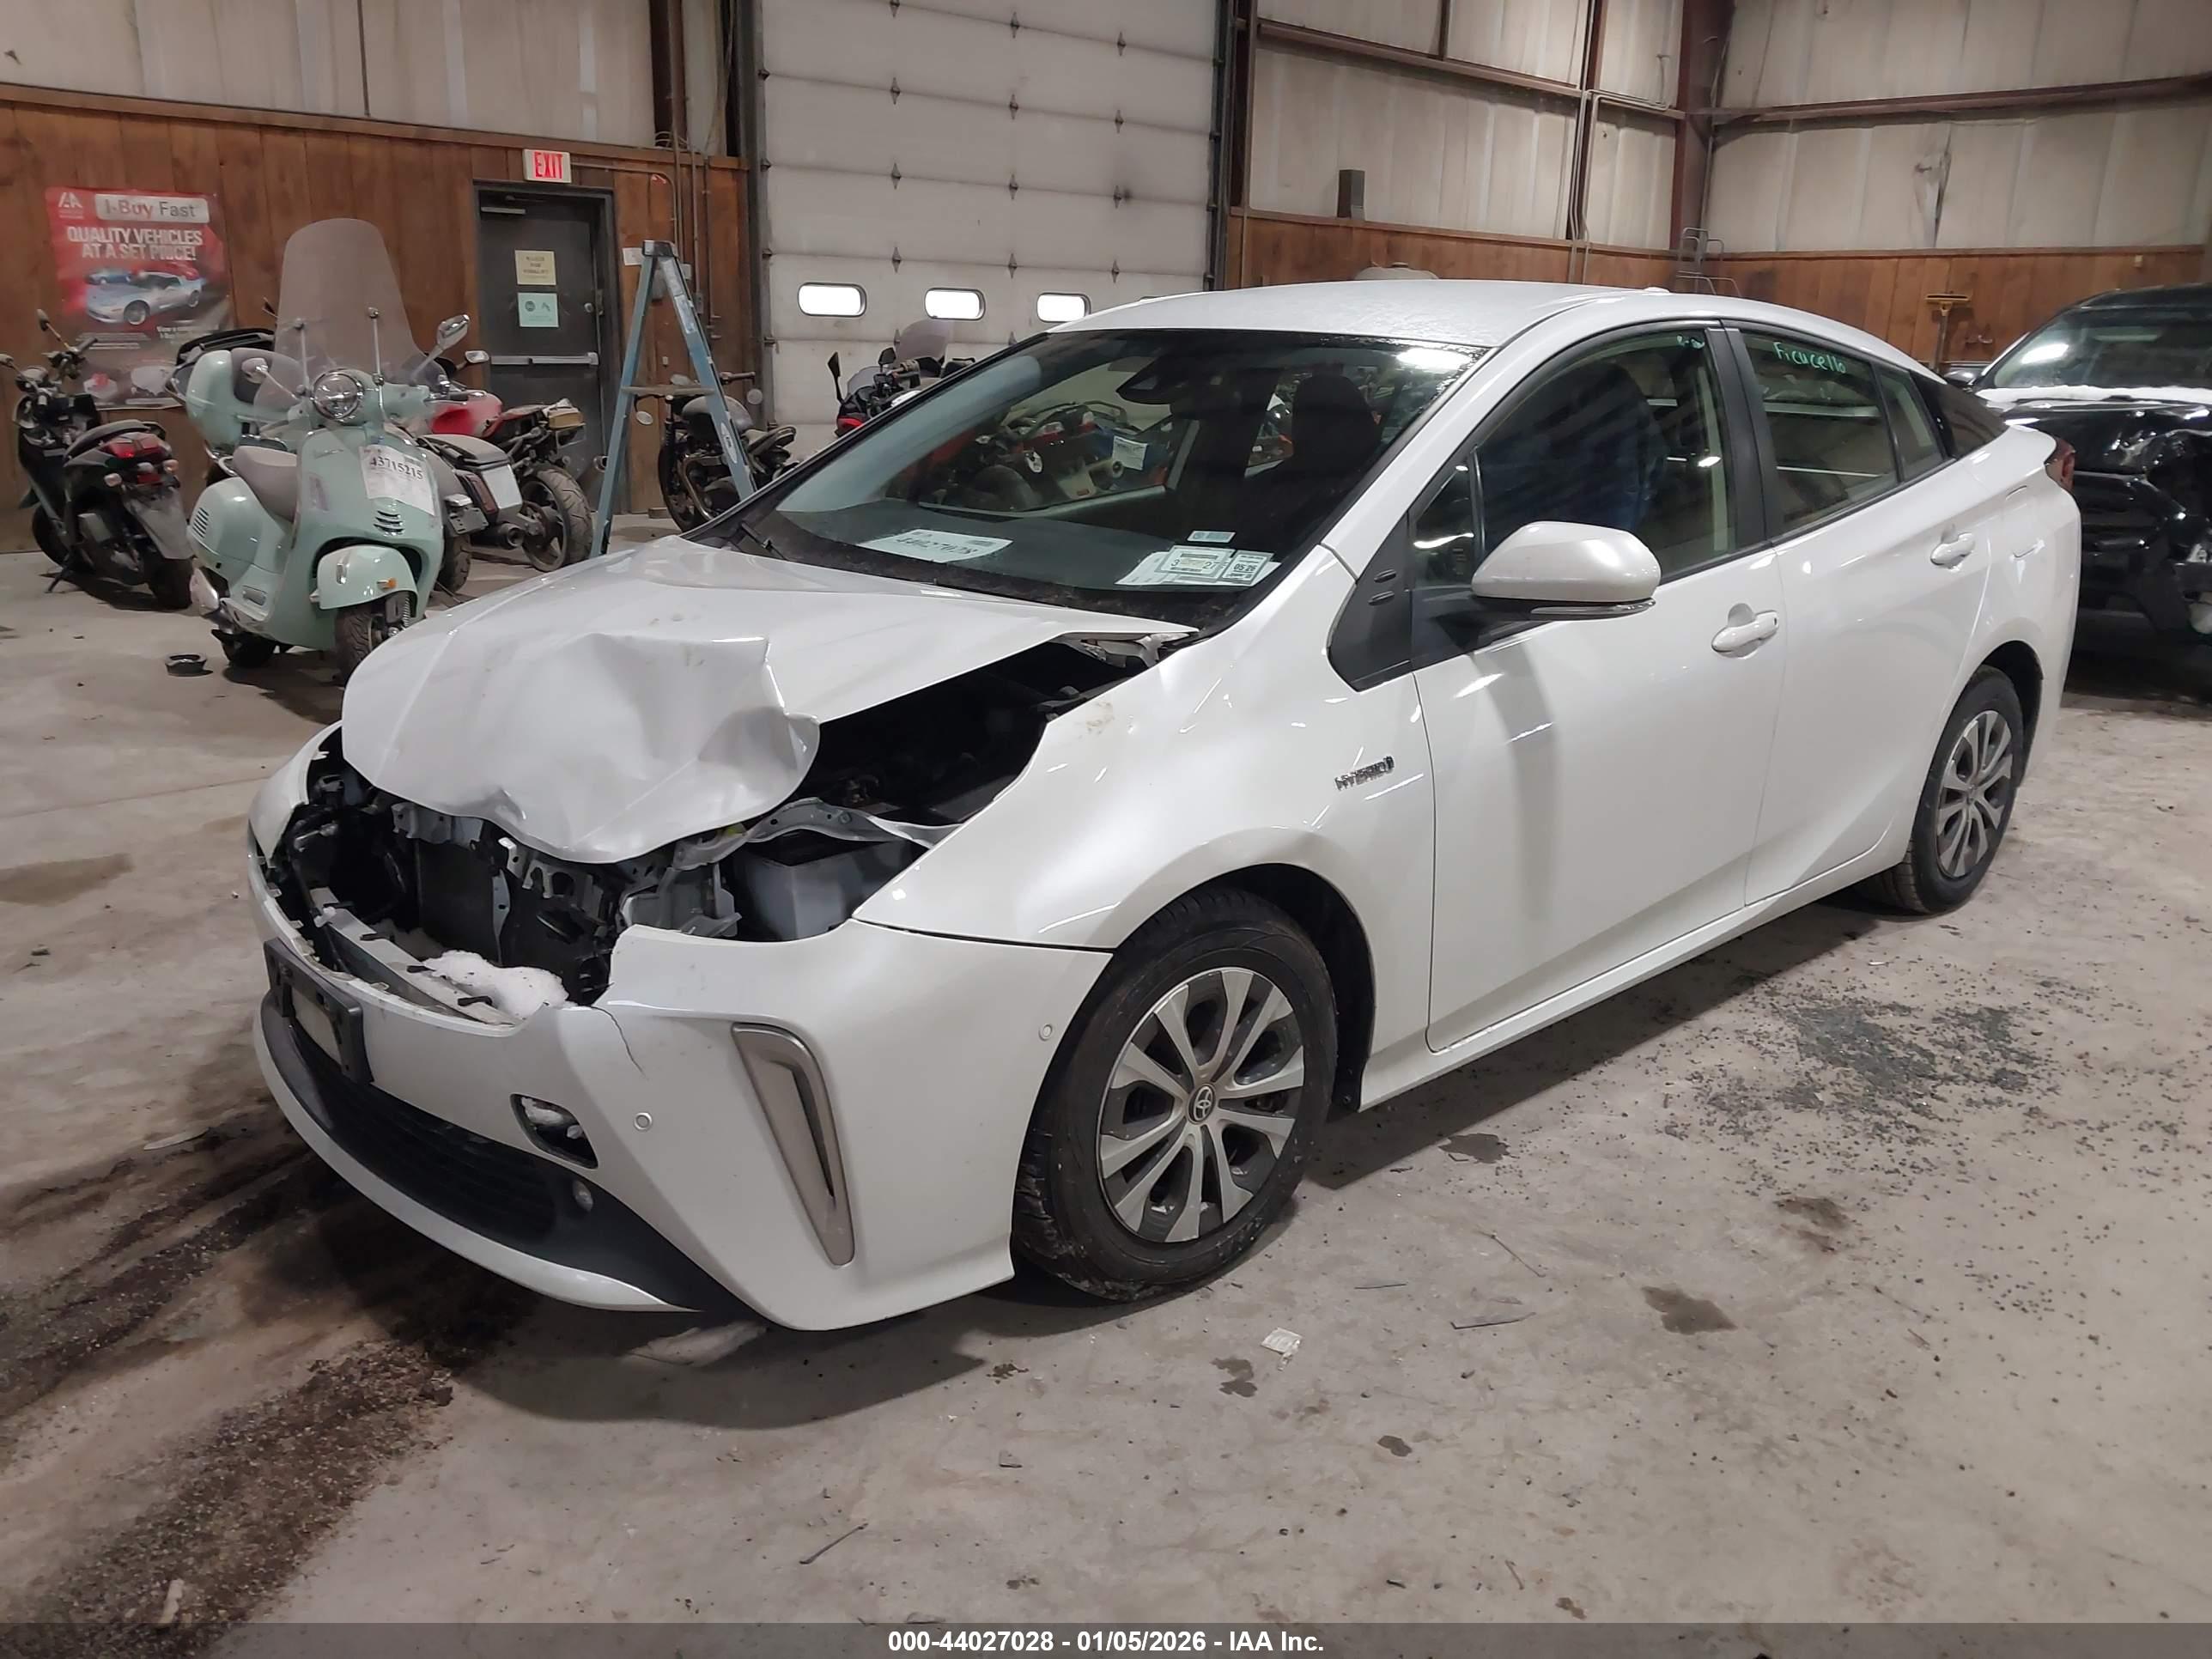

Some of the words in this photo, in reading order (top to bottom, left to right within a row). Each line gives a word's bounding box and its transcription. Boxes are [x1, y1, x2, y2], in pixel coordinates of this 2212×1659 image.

[534, 151, 563, 179] EXIT
[105, 198, 153, 219] I-Buy
[159, 201, 197, 217] Fast
[67, 226, 130, 243] QUALITY
[133, 228, 204, 246] VEHICLES
[82, 243, 104, 258] AT
[106, 244, 118, 258] A
[119, 244, 147, 259] SET
[149, 245, 198, 261] PRICE!
[369, 456, 424, 481] 43715215
